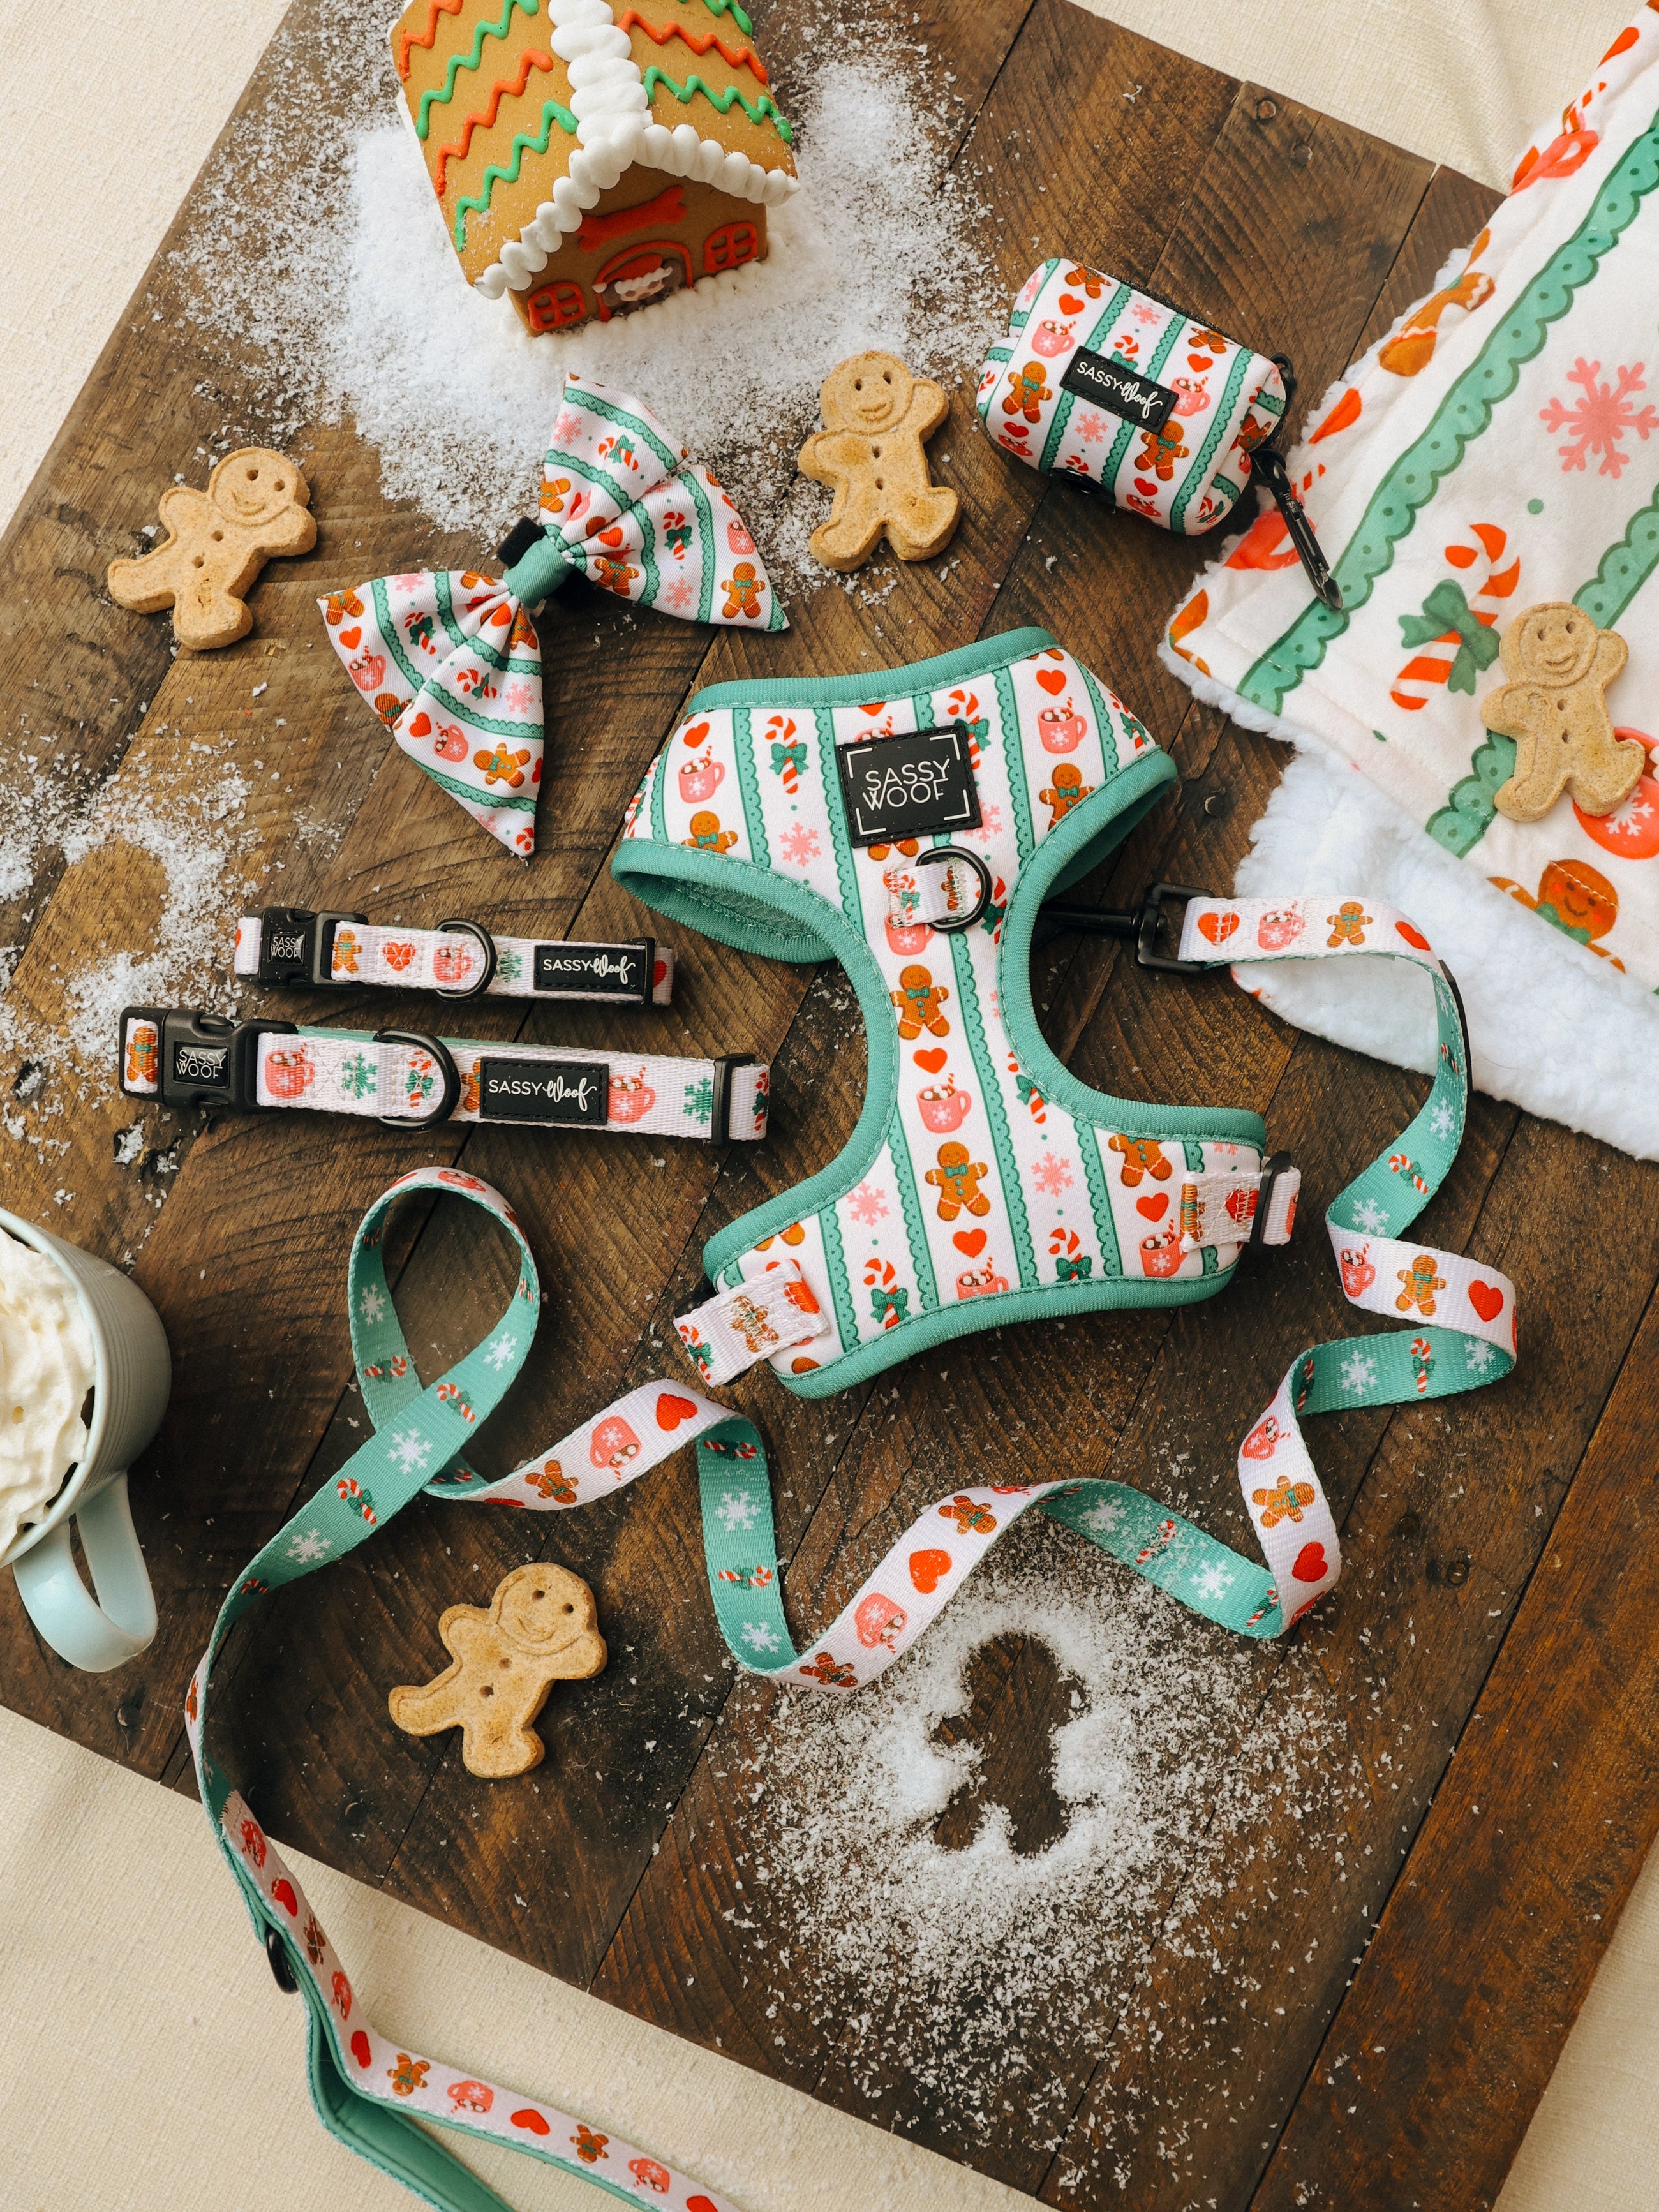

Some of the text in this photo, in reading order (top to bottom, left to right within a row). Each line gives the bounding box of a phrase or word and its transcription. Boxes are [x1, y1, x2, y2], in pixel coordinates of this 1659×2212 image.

[865, 758, 950, 792] SASSY
[862, 778, 949, 811] WOOF
[272, 937, 303, 947] SASSY
[271, 946, 301, 958] WOOF
[179, 1050, 226, 1067] SASSY
[176, 1061, 223, 1079] WOOF
